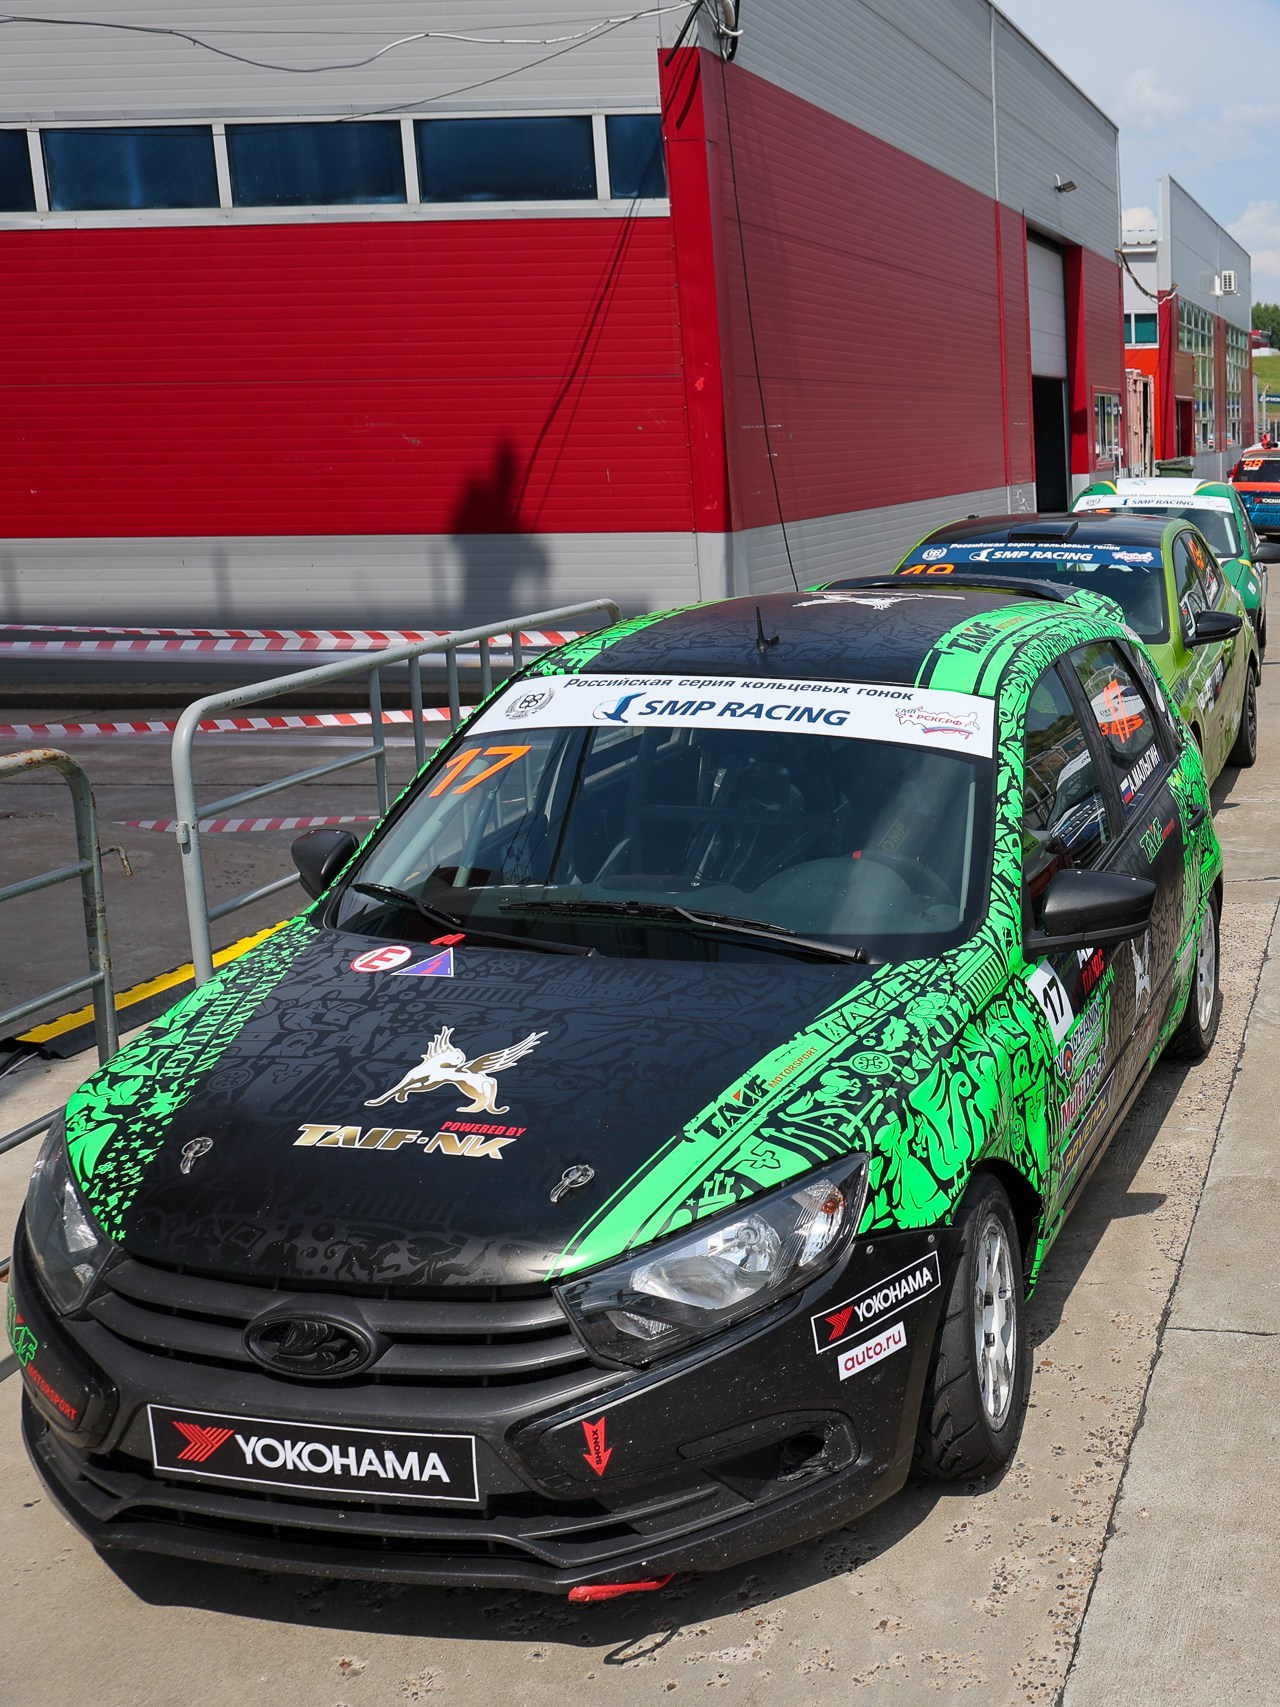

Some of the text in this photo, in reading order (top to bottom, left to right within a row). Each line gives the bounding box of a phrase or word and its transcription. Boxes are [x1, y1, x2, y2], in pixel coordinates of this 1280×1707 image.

[992, 551, 1094, 561] SMP RACING
[563, 677, 915, 701] Российская серия кольцевых гонок
[638, 700, 851, 726] SMP RACING
[916, 714, 963, 726] РСКГ.РФ
[428, 745, 533, 798] 17
[189, 970, 288, 1075] TATARSTAN
[1042, 975, 1065, 1026] 17
[155, 992, 244, 1080] HERITAGE
[768, 1046, 818, 1088] MOTORSPORT
[440, 1121, 527, 1137] POWERED BY
[854, 1266, 933, 1323] YOKOHAMA
[844, 1330, 902, 1372] auto.ru
[26, 1362, 77, 1421] MOTORSPORT
[235, 1434, 451, 1484] YOKOHAMA
